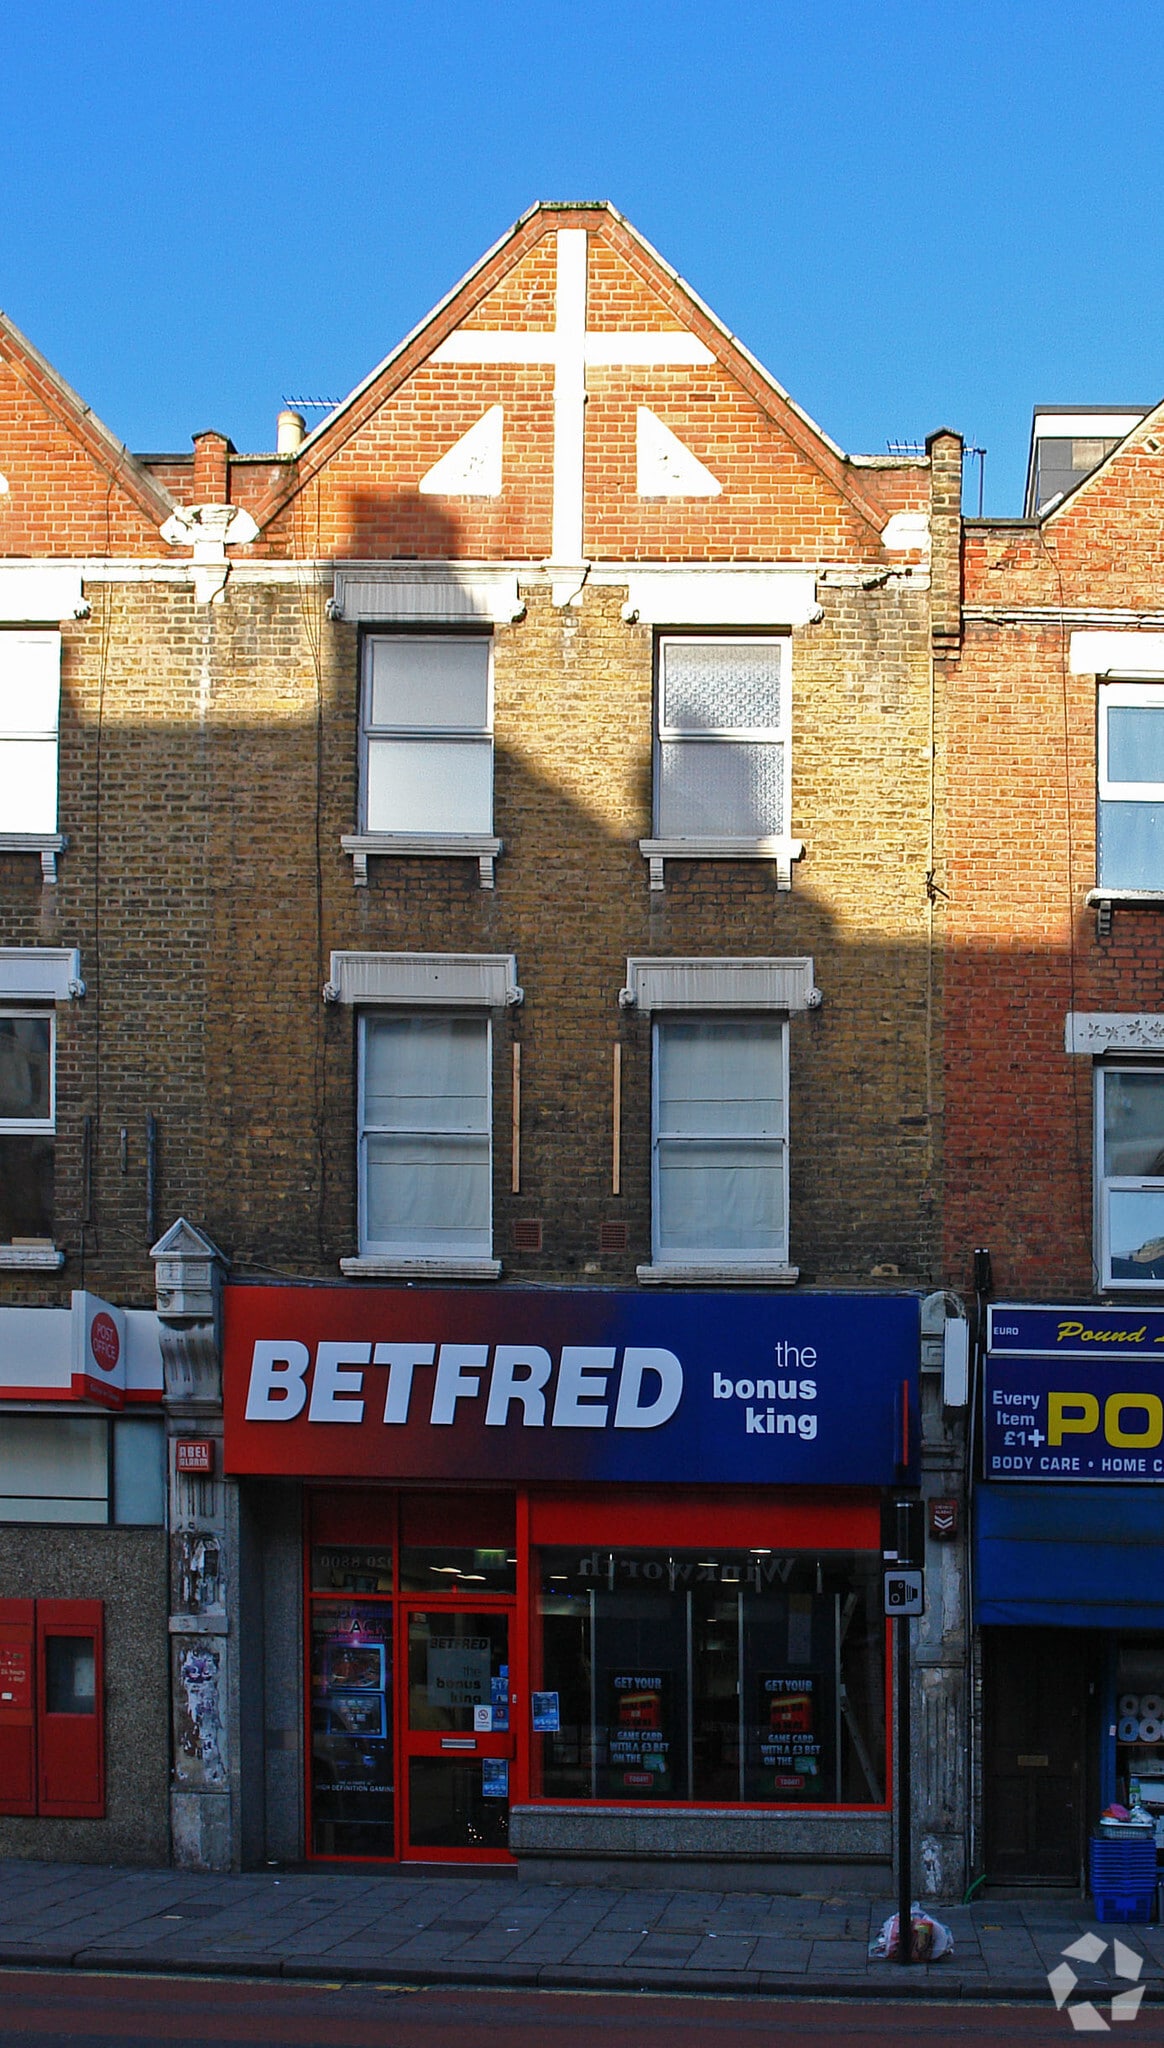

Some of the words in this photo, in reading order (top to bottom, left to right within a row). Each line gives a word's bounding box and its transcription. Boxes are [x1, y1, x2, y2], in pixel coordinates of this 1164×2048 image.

[96, 1323, 114, 1342] POST
[993, 1326, 1020, 1336] EURO
[1056, 1320, 1148, 1343] Pound
[93, 1337, 117, 1361] OFFICE
[774, 1341, 818, 1368] the
[244, 1339, 684, 1429] BETFRED
[712, 1372, 817, 1400] bonus
[992, 1389, 1041, 1410] Every
[745, 1407, 818, 1440] king
[996, 1410, 1035, 1426] Item
[178, 1446, 209, 1458] ABEL
[991, 1456, 1034, 1470] BODY
[1039, 1456, 1081, 1471] CARE
[1101, 1457, 1147, 1472] HOME
[430, 1637, 488, 1649] BETFRED
[436, 1678, 482, 1690] bonus
[613, 1676, 632, 1689] GET
[634, 1677, 662, 1690] YOUR
[764, 1680, 783, 1691] GET
[784, 1680, 813, 1692] YOUR
[616, 1731, 640, 1741] GAME
[641, 1731, 663, 1741] CARD
[767, 1734, 791, 1743] GAME
[792, 1734, 815, 1743] CARD
[609, 1742, 631, 1752] WITH
[653, 1742, 671, 1753] BET
[760, 1745, 782, 1754] WITH
[804, 1745, 822, 1755] BET
[612, 1754, 626, 1763] ON
[626, 1754, 641, 1764] THE
[763, 1757, 776, 1766] ON
[776, 1757, 792, 1766] THE
